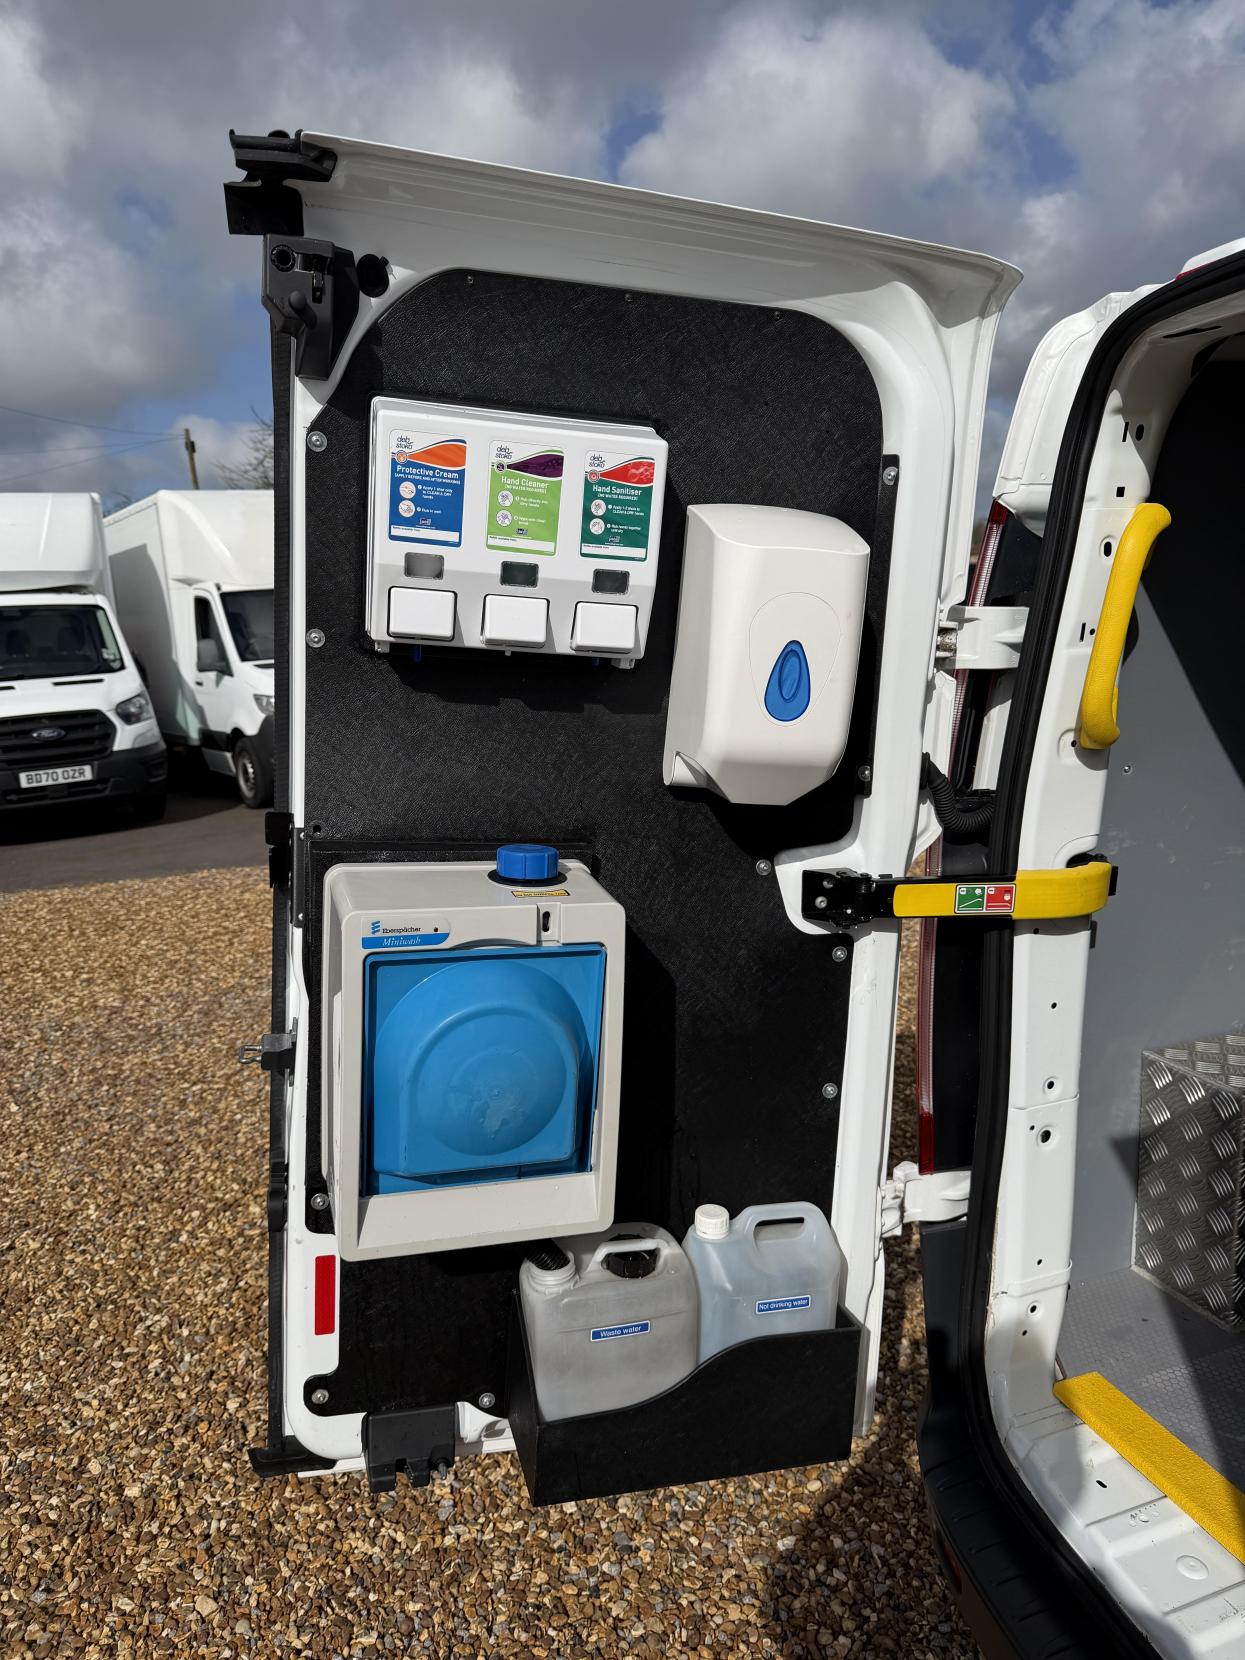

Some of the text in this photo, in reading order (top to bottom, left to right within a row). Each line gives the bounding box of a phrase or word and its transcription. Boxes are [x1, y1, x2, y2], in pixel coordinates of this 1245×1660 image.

[396, 465, 459, 479] Protective Cream
[502, 476, 549, 489] Hand Cleaner
[612, 486, 642, 496] Sanitiser
[26, 768, 86, 785] BD70 OZR
[382, 936, 421, 946] Miniwash
[622, 1326, 642, 1334] water
